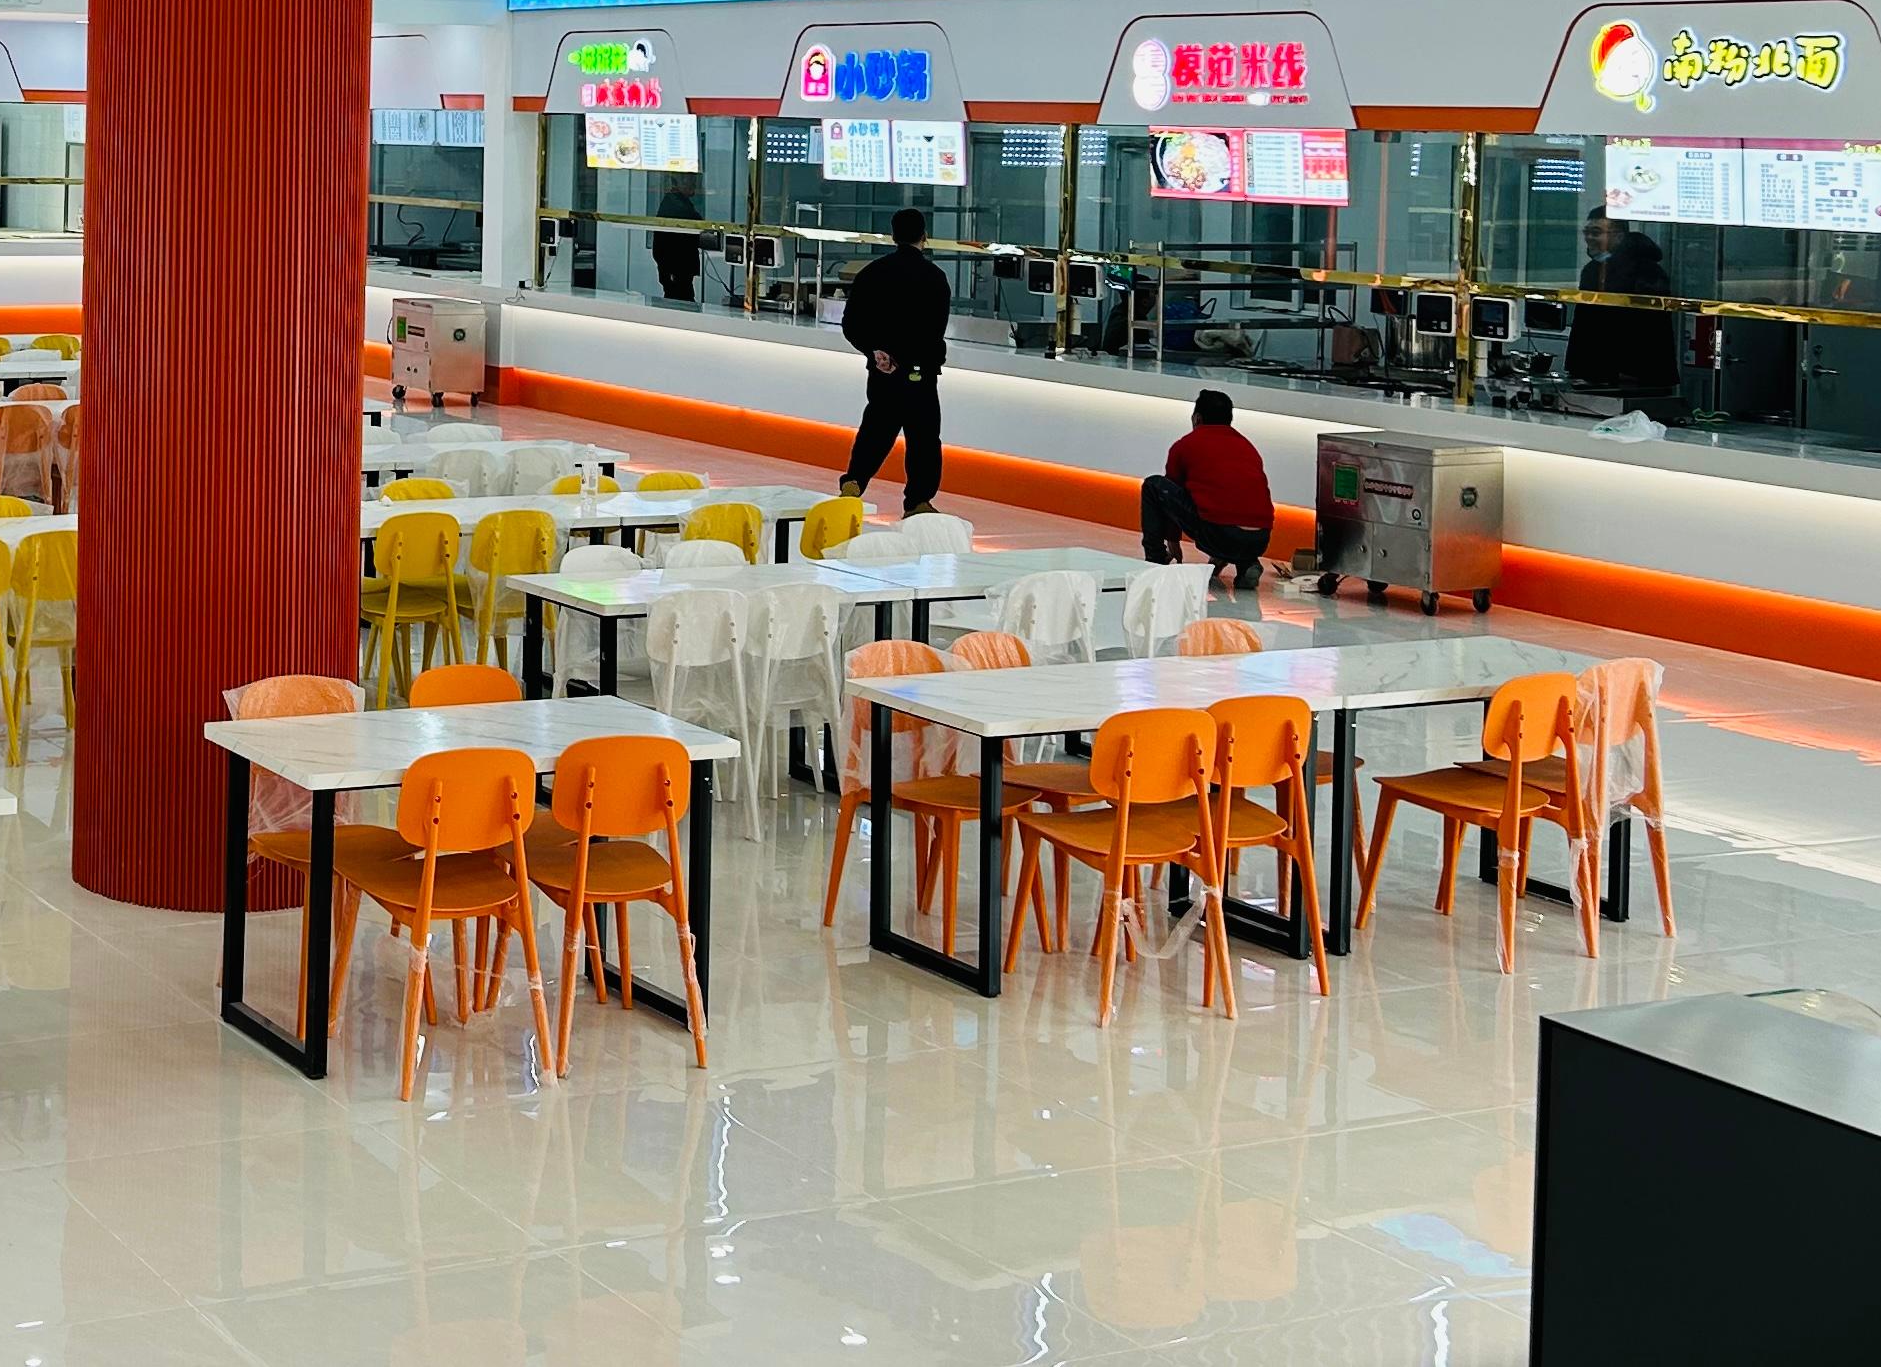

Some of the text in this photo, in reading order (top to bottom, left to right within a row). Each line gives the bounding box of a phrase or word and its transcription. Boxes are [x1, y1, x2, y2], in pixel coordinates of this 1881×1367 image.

[835, 49, 929, 102] 小砂锅
[1171, 42, 1307, 89] 模范米线
[1662, 29, 1841, 90] 南粉北面
